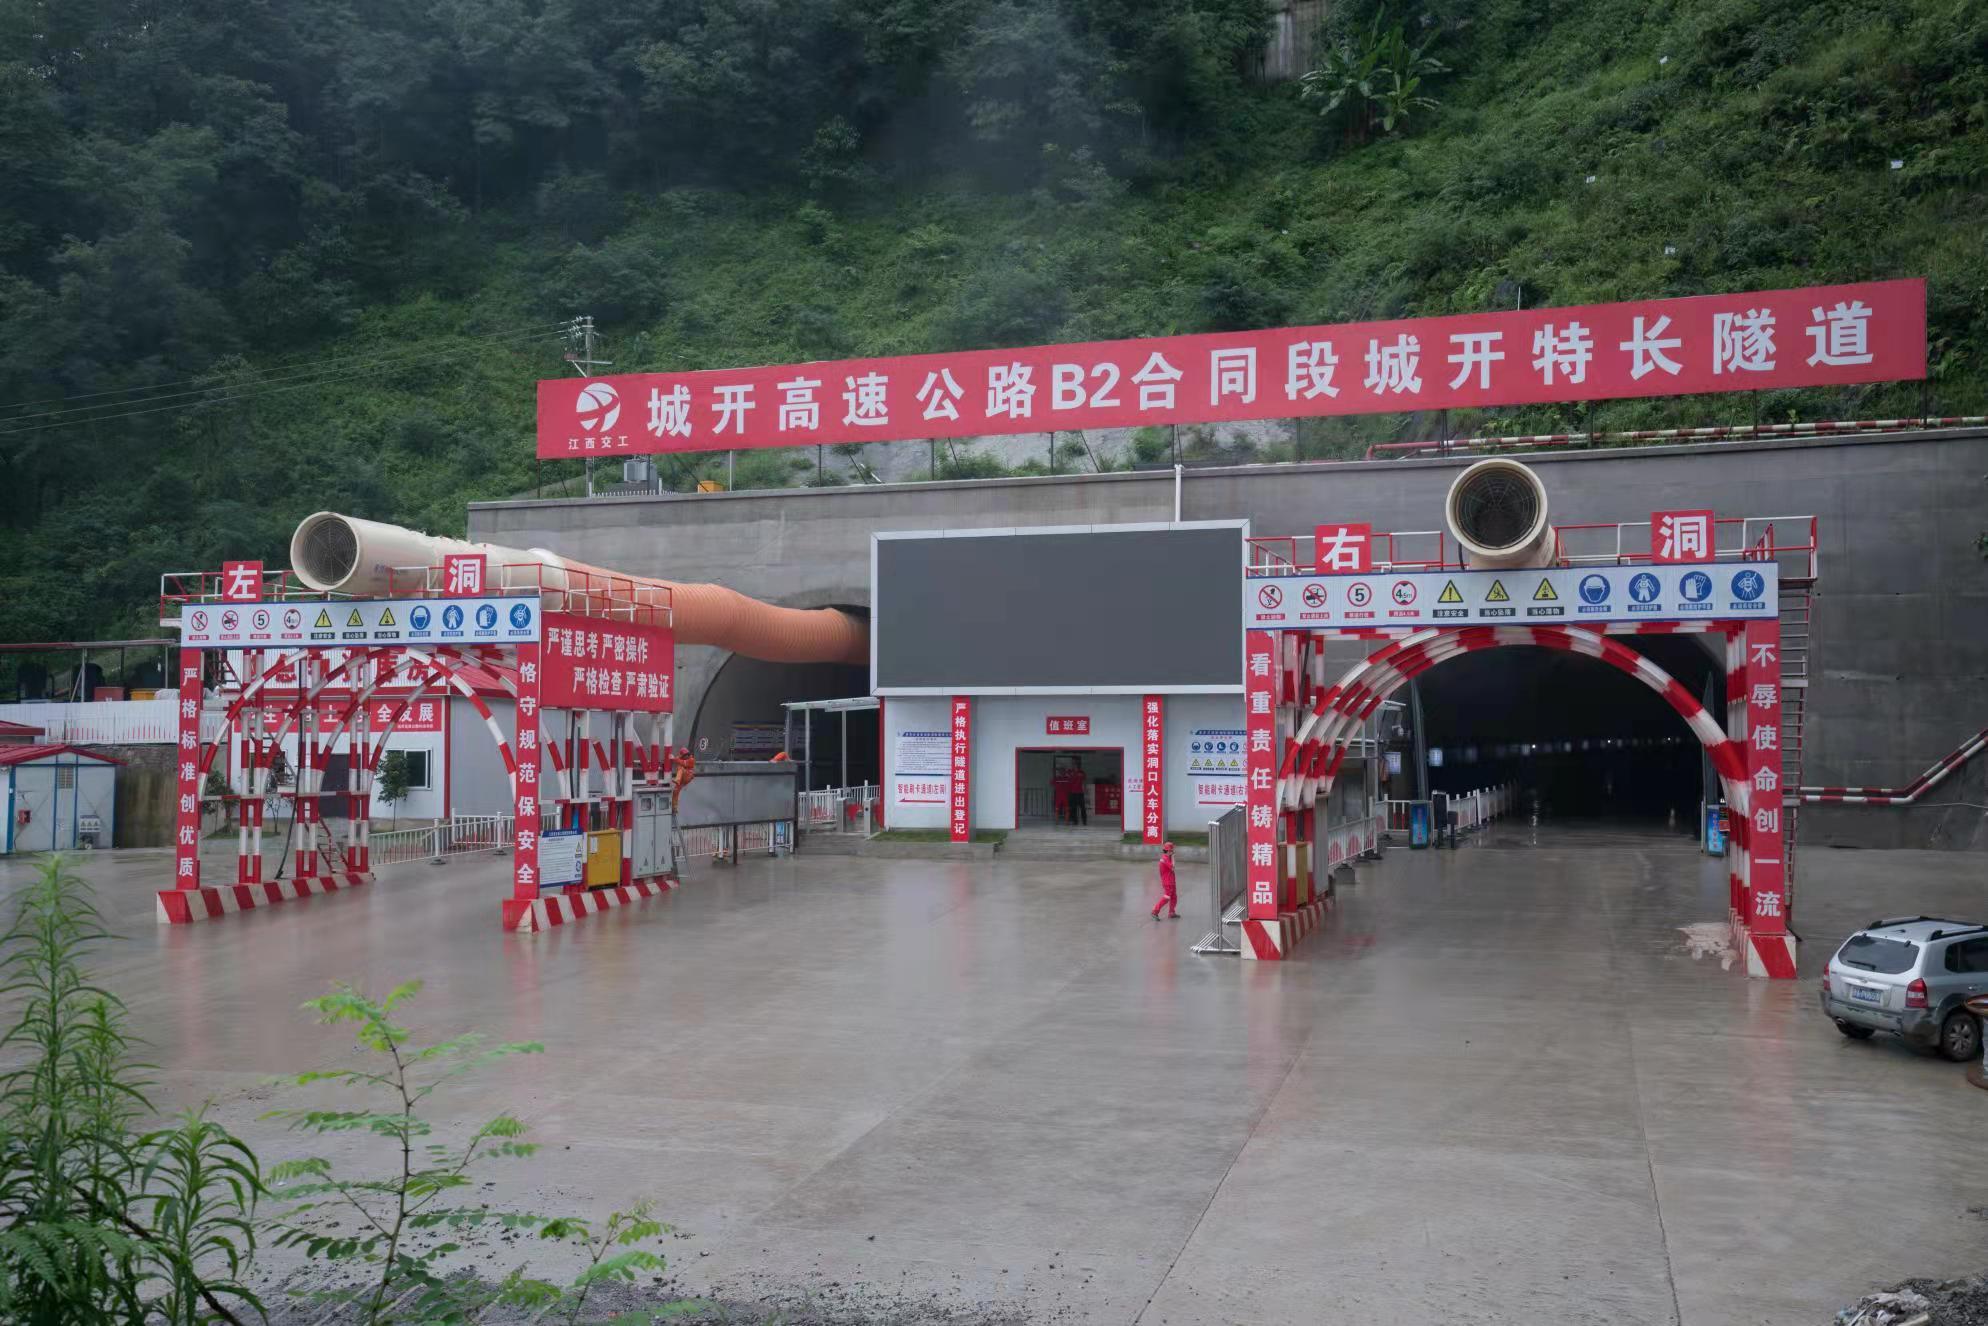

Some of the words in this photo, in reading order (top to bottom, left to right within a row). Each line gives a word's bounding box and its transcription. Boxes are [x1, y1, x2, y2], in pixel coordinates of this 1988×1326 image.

[647, 301, 1874, 438] 城开高速公路B2合同段城开特长隧道
[568, 434, 629, 450] 江西交工
[1322, 528, 1366, 570] 右
[1660, 515, 1708, 560] 洞
[227, 564, 258, 598] 左
[449, 558, 481, 594] 洞
[1355, 588, 1365, 602] 5
[257, 615, 266, 626] 5
[547, 627, 599, 659] 严谨思考
[601, 633, 649, 664] 严密操作
[573, 666, 623, 696] 严格检查
[625, 671, 670, 698] 严肃验证
[1049, 719, 1088, 732] 值班室
[178, 667, 198, 877] 严格标准创优质
[517, 662, 537, 884] 恪守规范保安全
[954, 702, 967, 835] 严格执行隧道进出登记
[1146, 701, 1160, 838] 强化落实洞口人车分离
[1250, 653, 1274, 905] 看重责任铸精品
[1751, 643, 1782, 917] 不辱使命创一流
